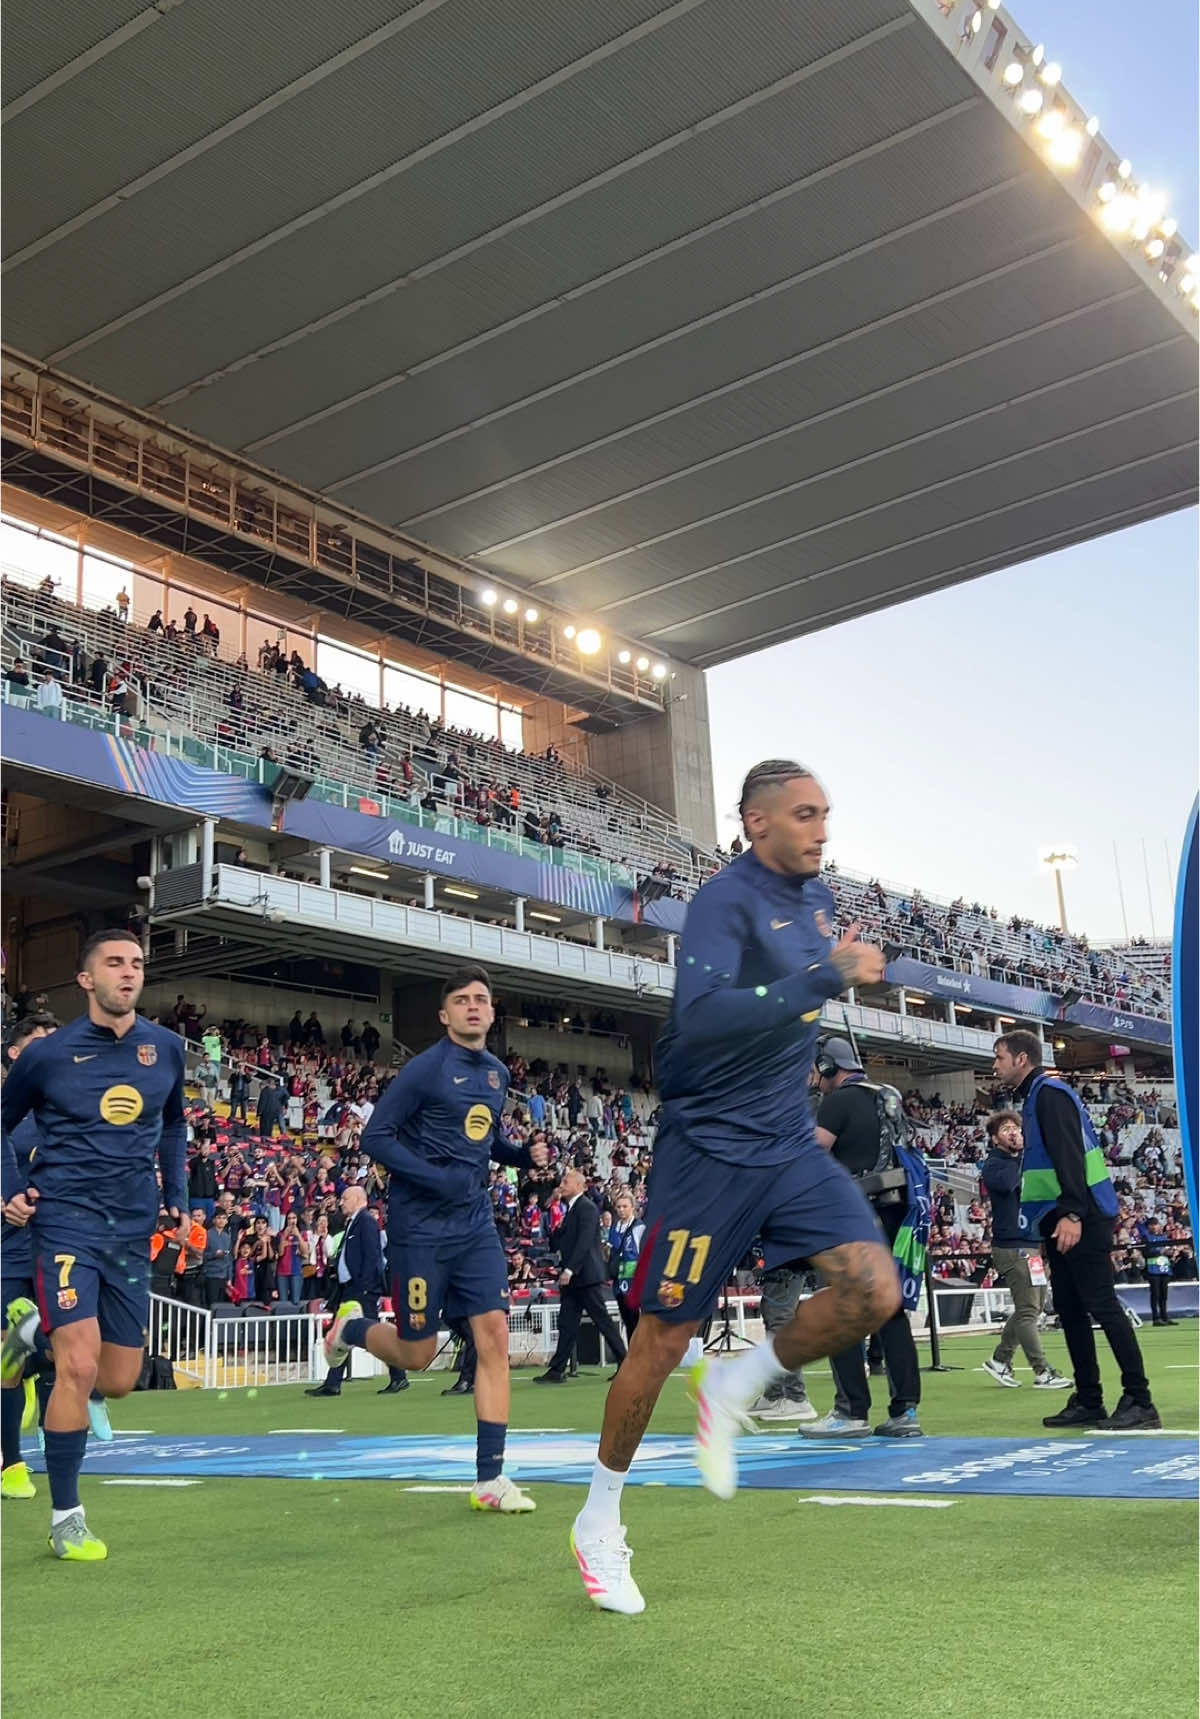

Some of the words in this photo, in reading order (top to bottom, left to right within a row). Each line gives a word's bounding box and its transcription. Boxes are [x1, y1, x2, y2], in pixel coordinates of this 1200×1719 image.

[406, 841, 434, 860] JUST
[435, 848, 457, 865] EAT
[54, 1253, 77, 1288] 7
[663, 1228, 712, 1285] 11
[407, 1276, 428, 1311] 8
